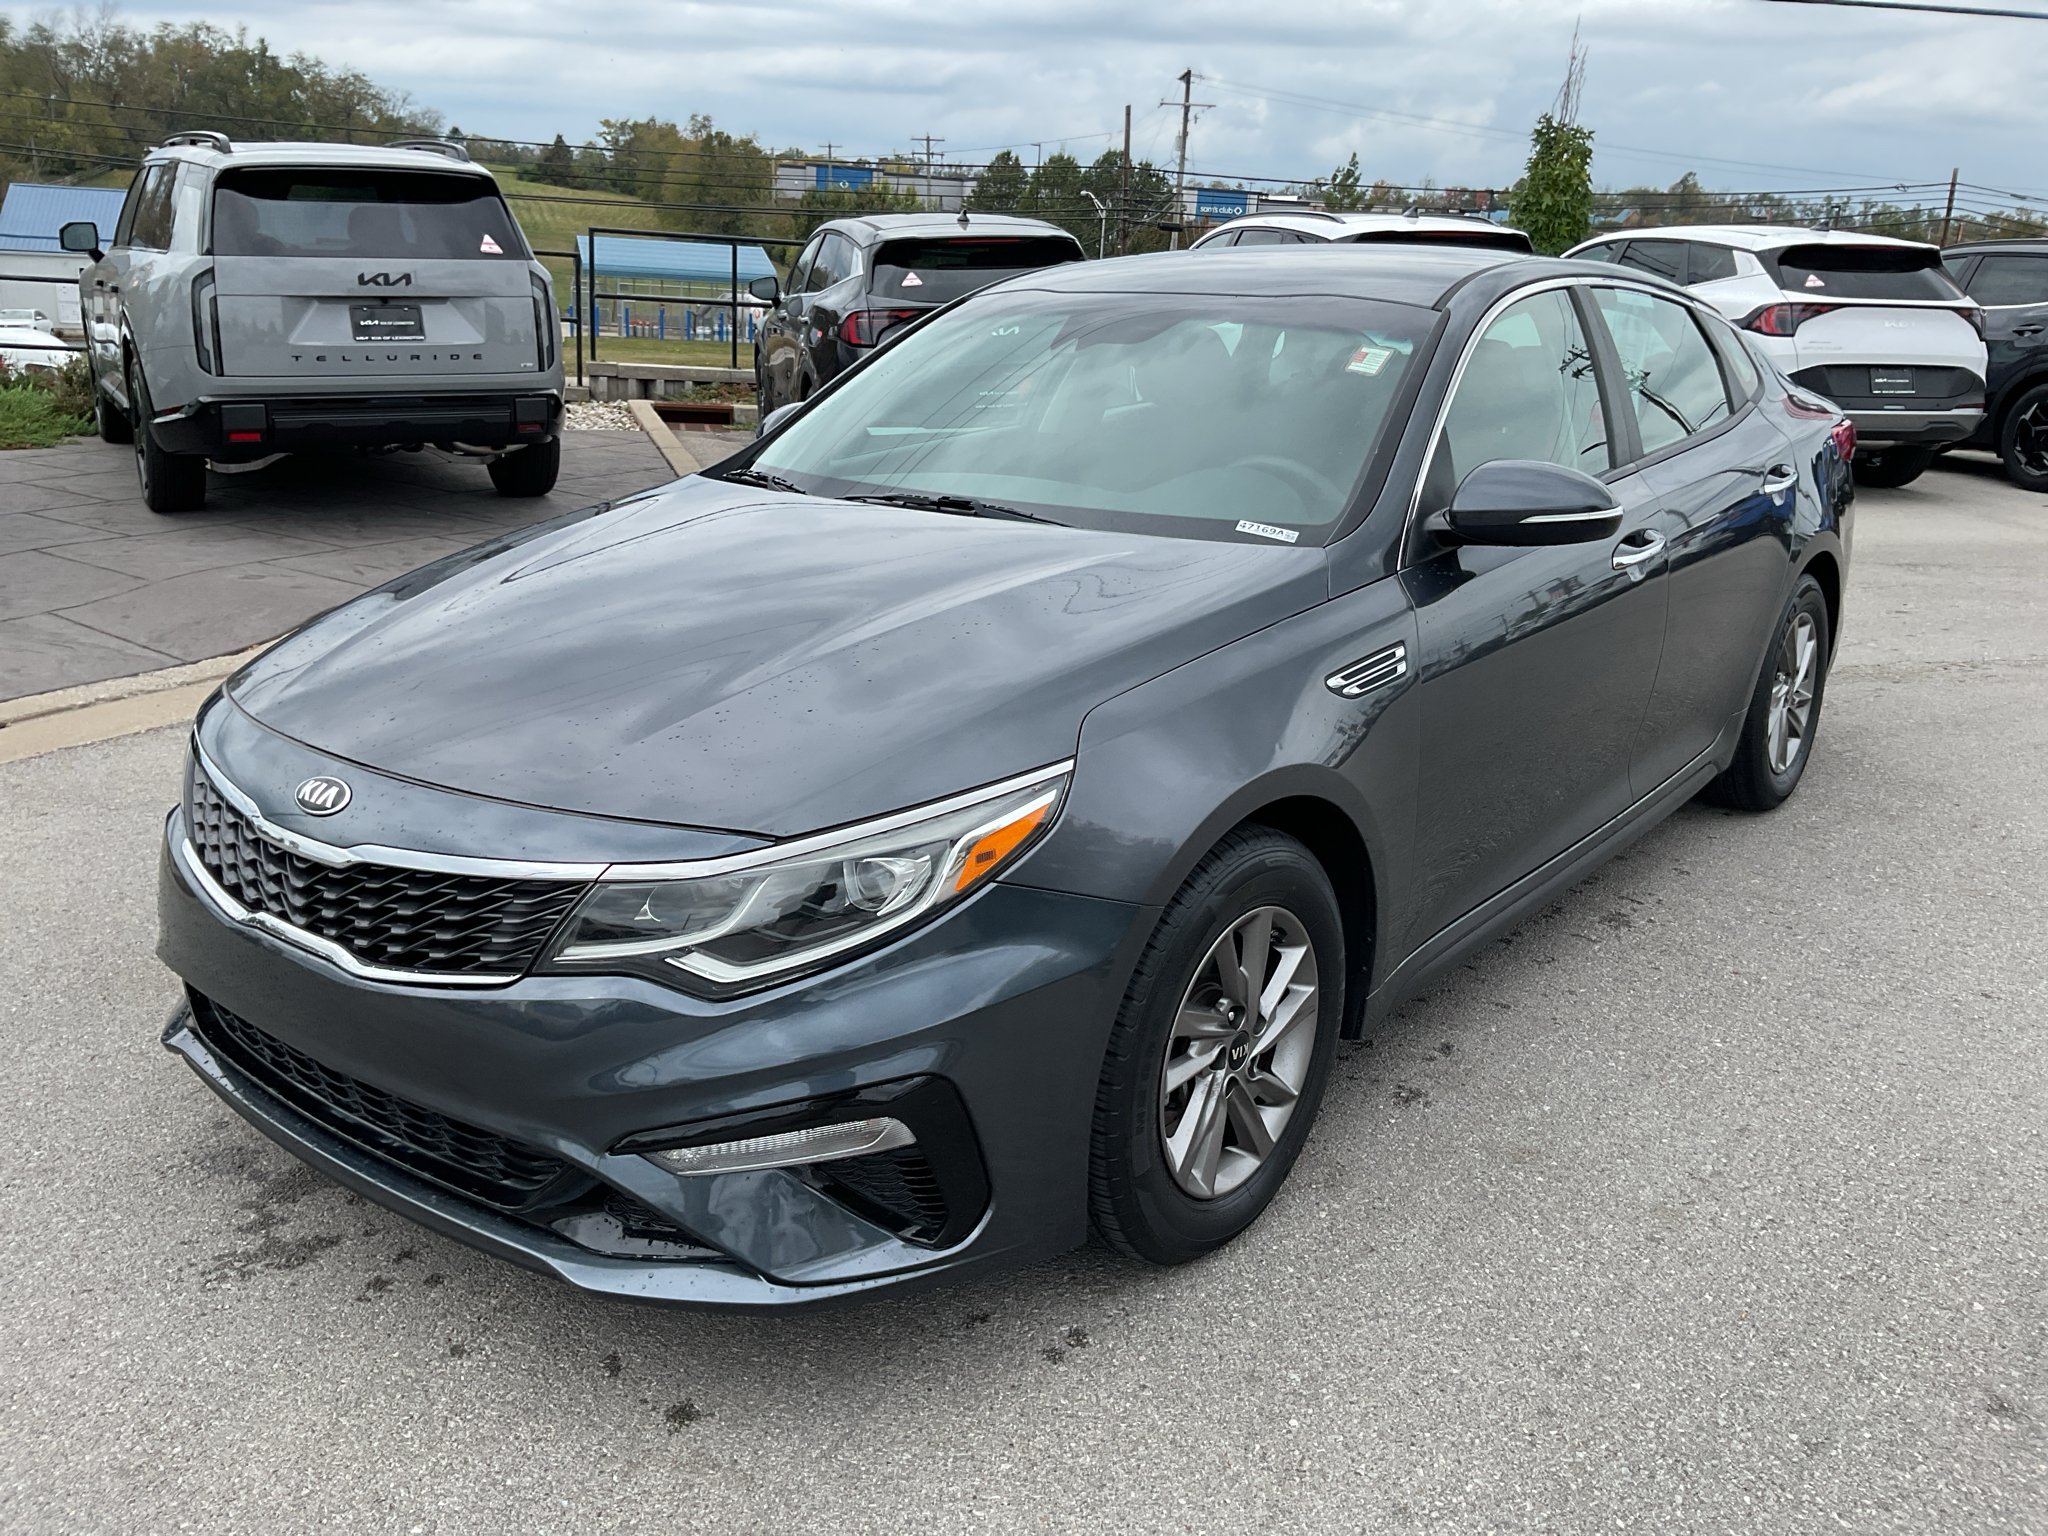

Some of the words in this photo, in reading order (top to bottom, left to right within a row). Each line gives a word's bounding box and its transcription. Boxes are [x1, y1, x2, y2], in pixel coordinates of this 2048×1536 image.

[1219, 206, 1233, 214] club
[357, 272, 412, 287] KIA
[291, 353, 484, 362] TELLURIDE
[298, 779, 340, 809] KIA
[1232, 1042, 1249, 1060] KIA
